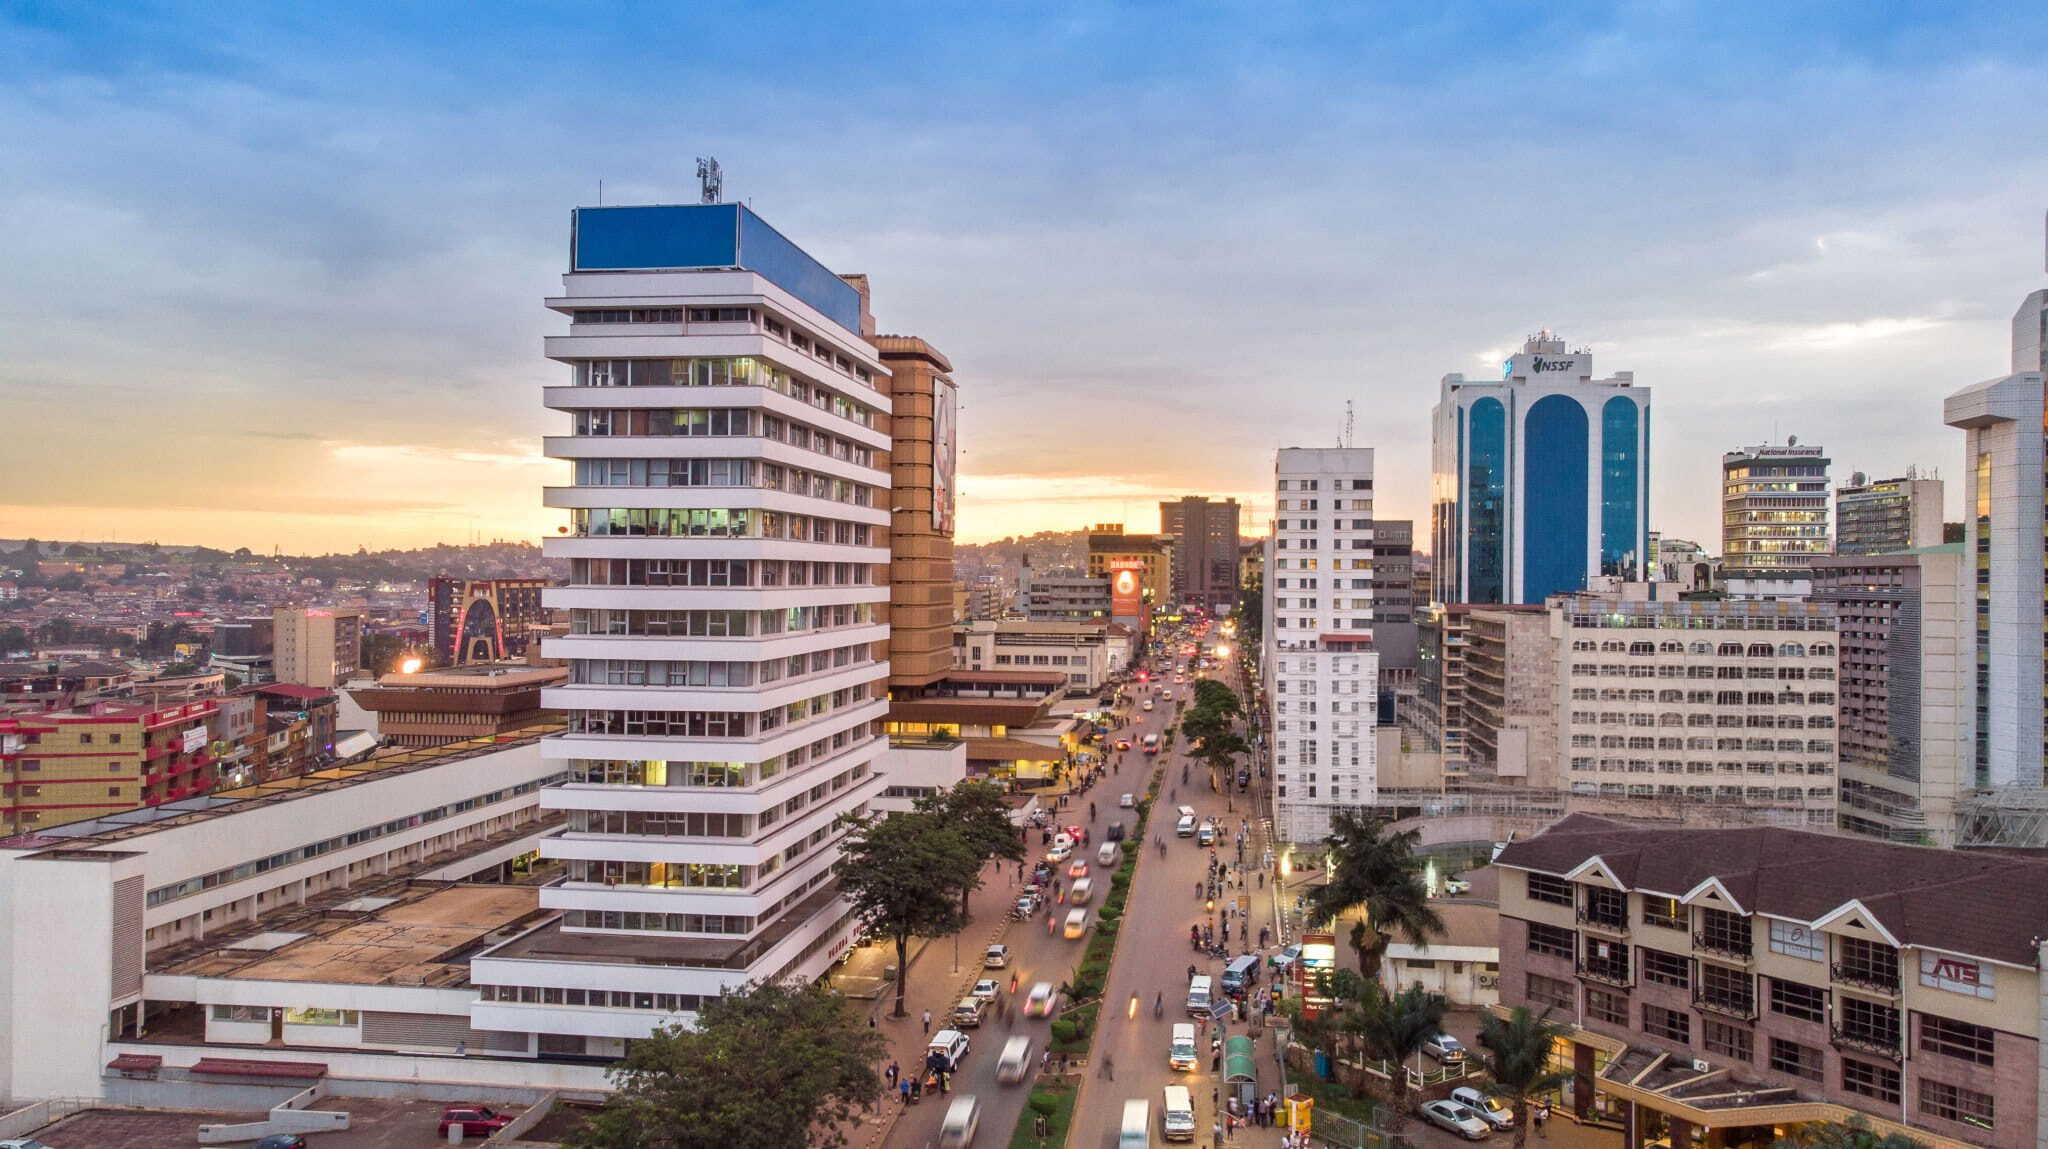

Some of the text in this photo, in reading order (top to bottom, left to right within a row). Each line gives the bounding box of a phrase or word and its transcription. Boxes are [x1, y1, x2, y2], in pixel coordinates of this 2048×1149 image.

[1541, 360, 1575, 372] NSSF
[1760, 448, 1787, 456] National
[1931, 958, 1980, 985] ATS
